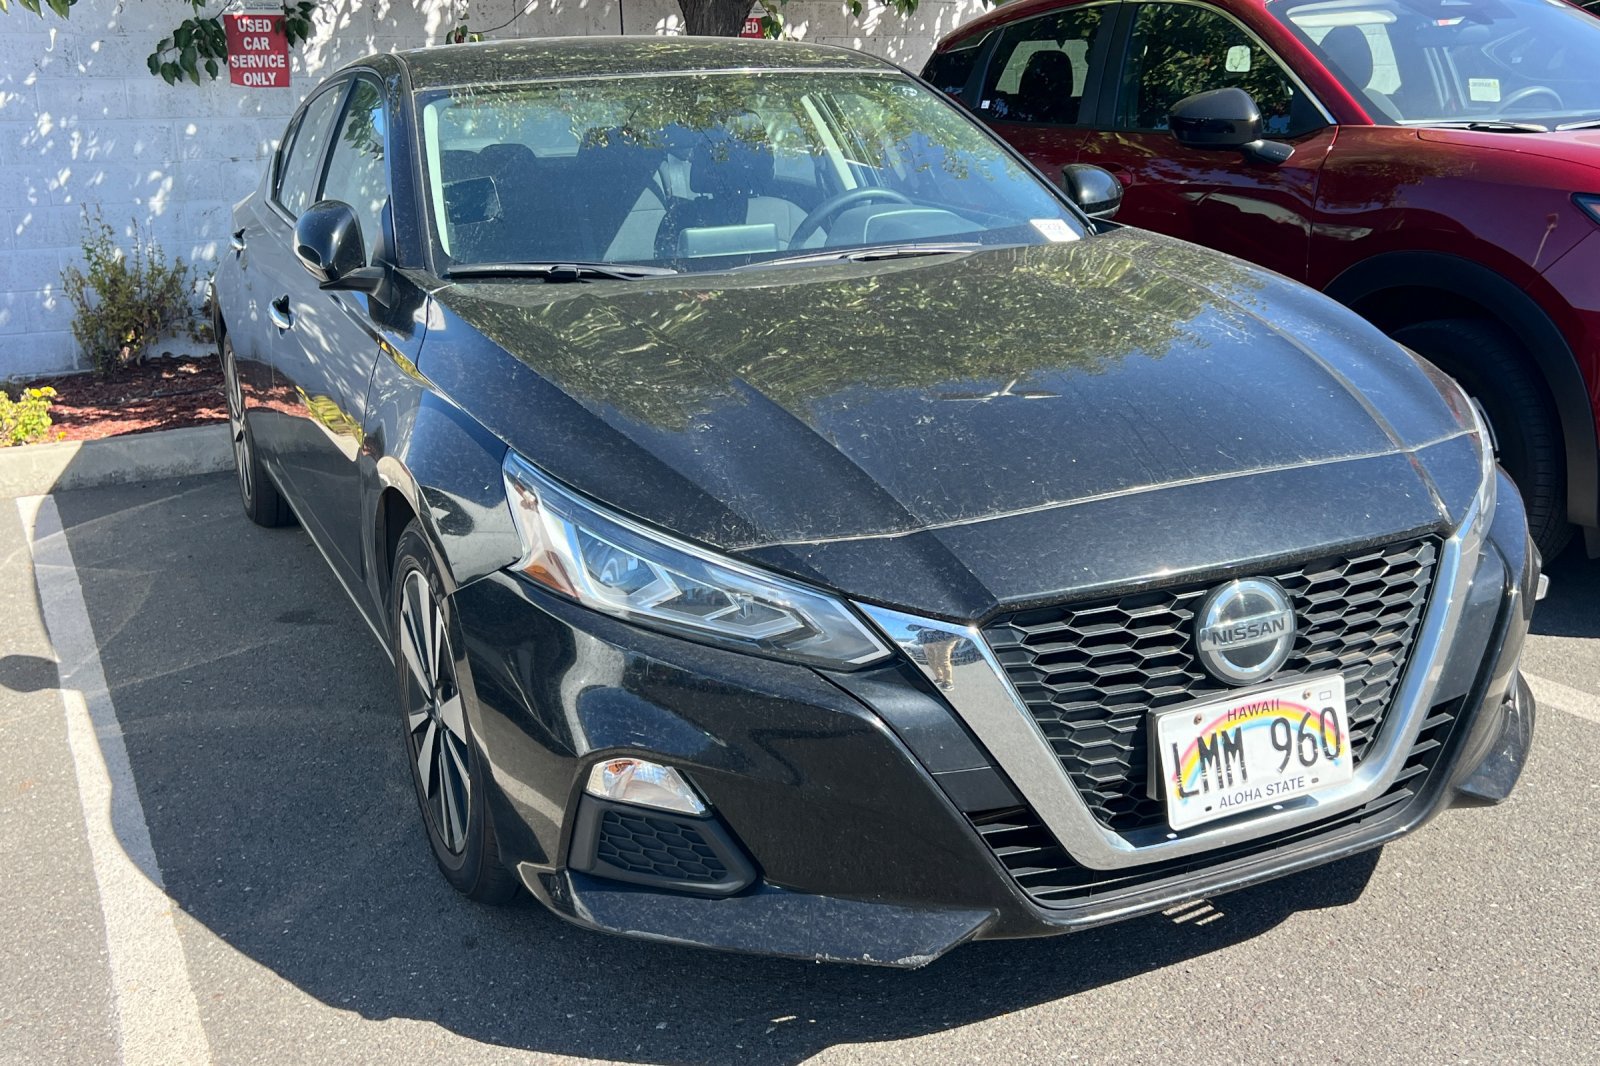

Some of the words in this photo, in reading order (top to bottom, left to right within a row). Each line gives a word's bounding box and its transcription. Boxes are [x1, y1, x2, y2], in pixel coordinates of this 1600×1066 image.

[237, 19, 272, 33] USED
[243, 37, 270, 50] CAR
[231, 55, 286, 68] SERVICE
[243, 72, 276, 86] ONLY
[1212, 617, 1285, 645] NISSAN
[1227, 698, 1280, 722] HAWAII
[1172, 726, 1248, 799] LMM
[1270, 706, 1341, 774] 960
[1219, 788, 1262, 809] ALOHA
[1266, 776, 1305, 796] STATE
